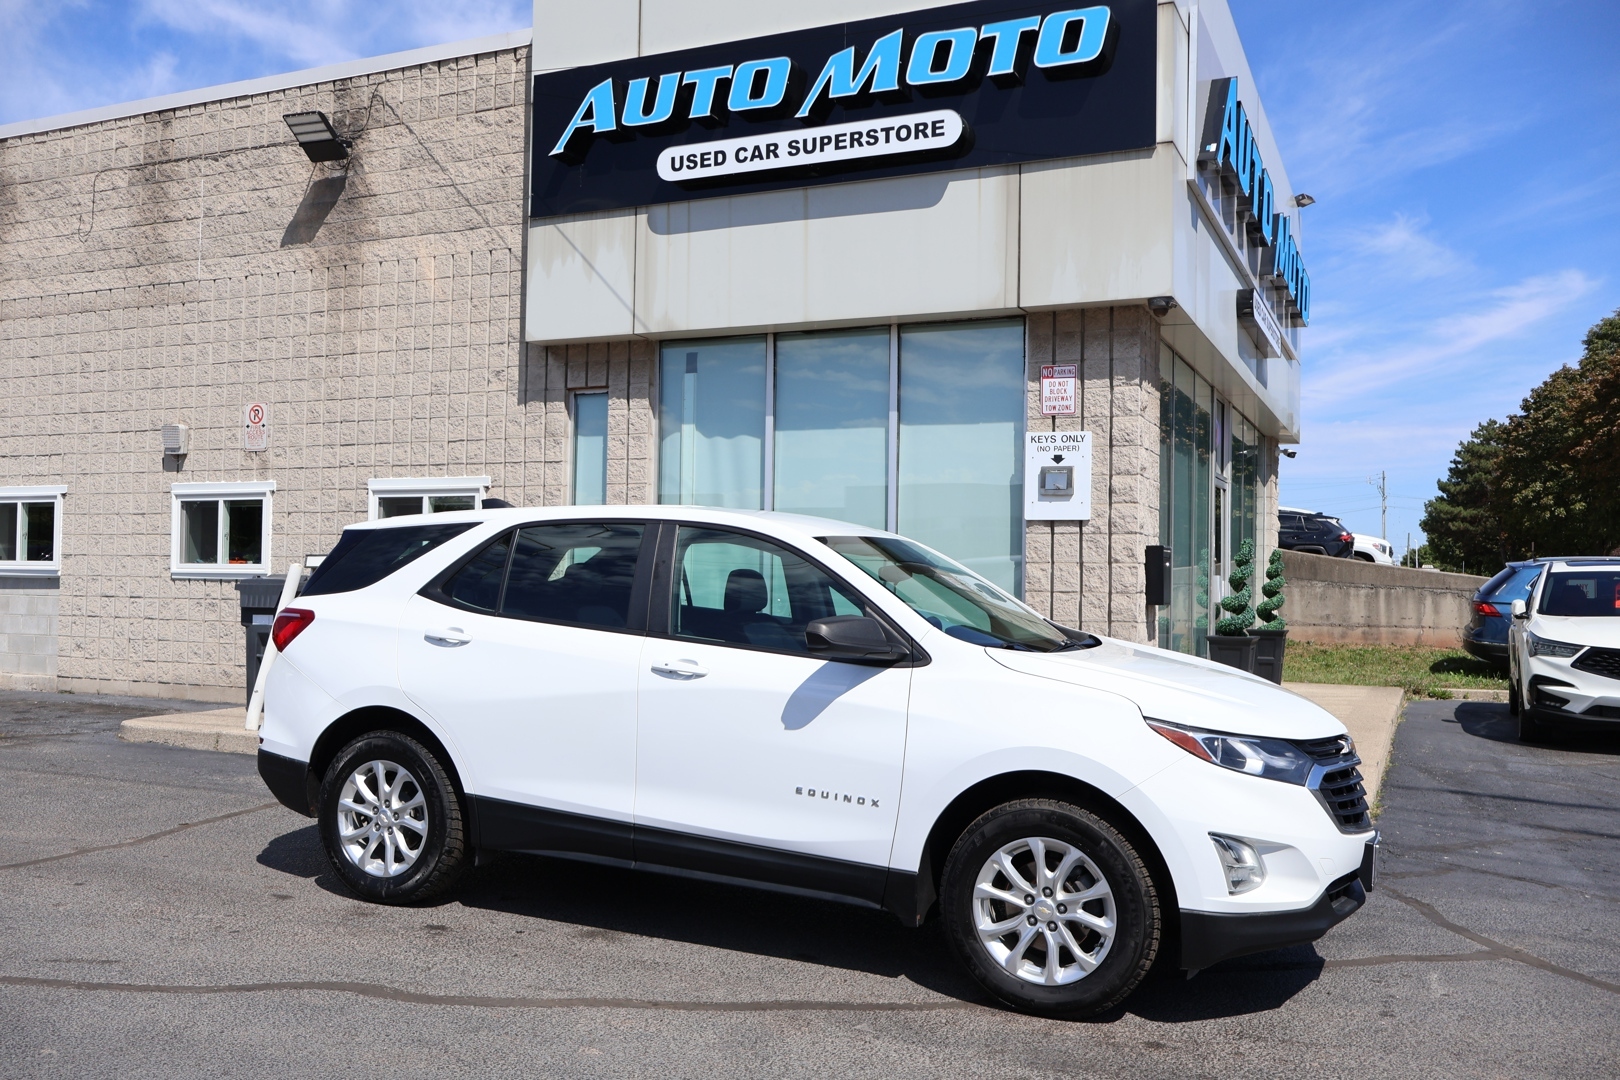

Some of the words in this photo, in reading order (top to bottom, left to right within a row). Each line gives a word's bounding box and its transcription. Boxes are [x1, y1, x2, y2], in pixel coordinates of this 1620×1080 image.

[548, 56, 791, 156] AUTO
[794, 5, 1111, 118] MOTO
[670, 149, 727, 172] USED
[734, 142, 780, 164] CAR
[787, 119, 946, 157] SUPERSTORE
[1217, 76, 1274, 247] AUTO
[1273, 212, 1311, 328] MOTO
[1043, 368, 1053, 377] NO
[1053, 368, 1075, 377] PARKING
[1044, 395, 1073, 403] DRIVEWAY
[1030, 435, 1057, 444] KEYS
[1060, 434, 1086, 443] ONLY
[1053, 444, 1080, 452] PAPER)
[795, 786, 880, 808] EQUINOX
